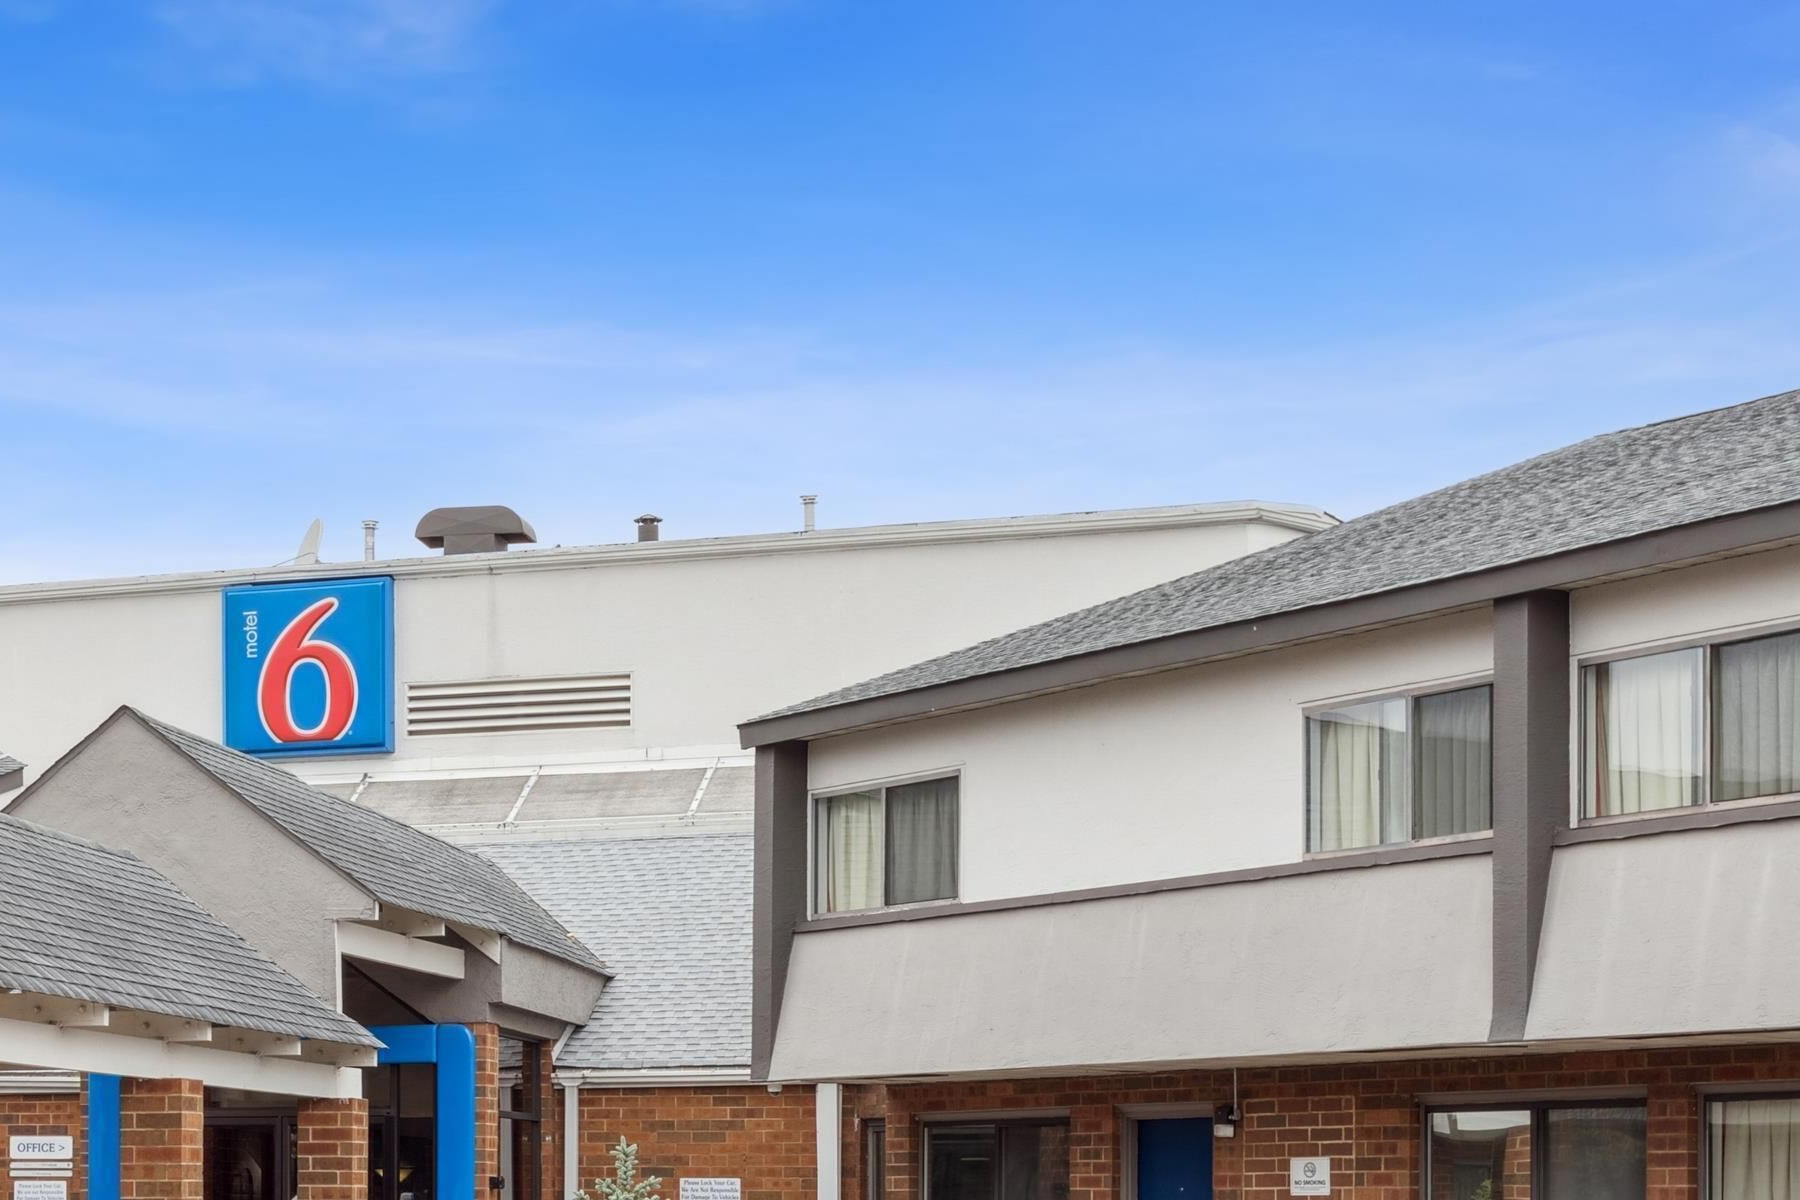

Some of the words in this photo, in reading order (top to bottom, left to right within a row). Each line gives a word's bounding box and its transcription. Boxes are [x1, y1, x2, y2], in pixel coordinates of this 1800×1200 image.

[243, 611, 257, 658] motel
[257, 597, 359, 743] 6
[17, 1142, 55, 1152] OFFICE
